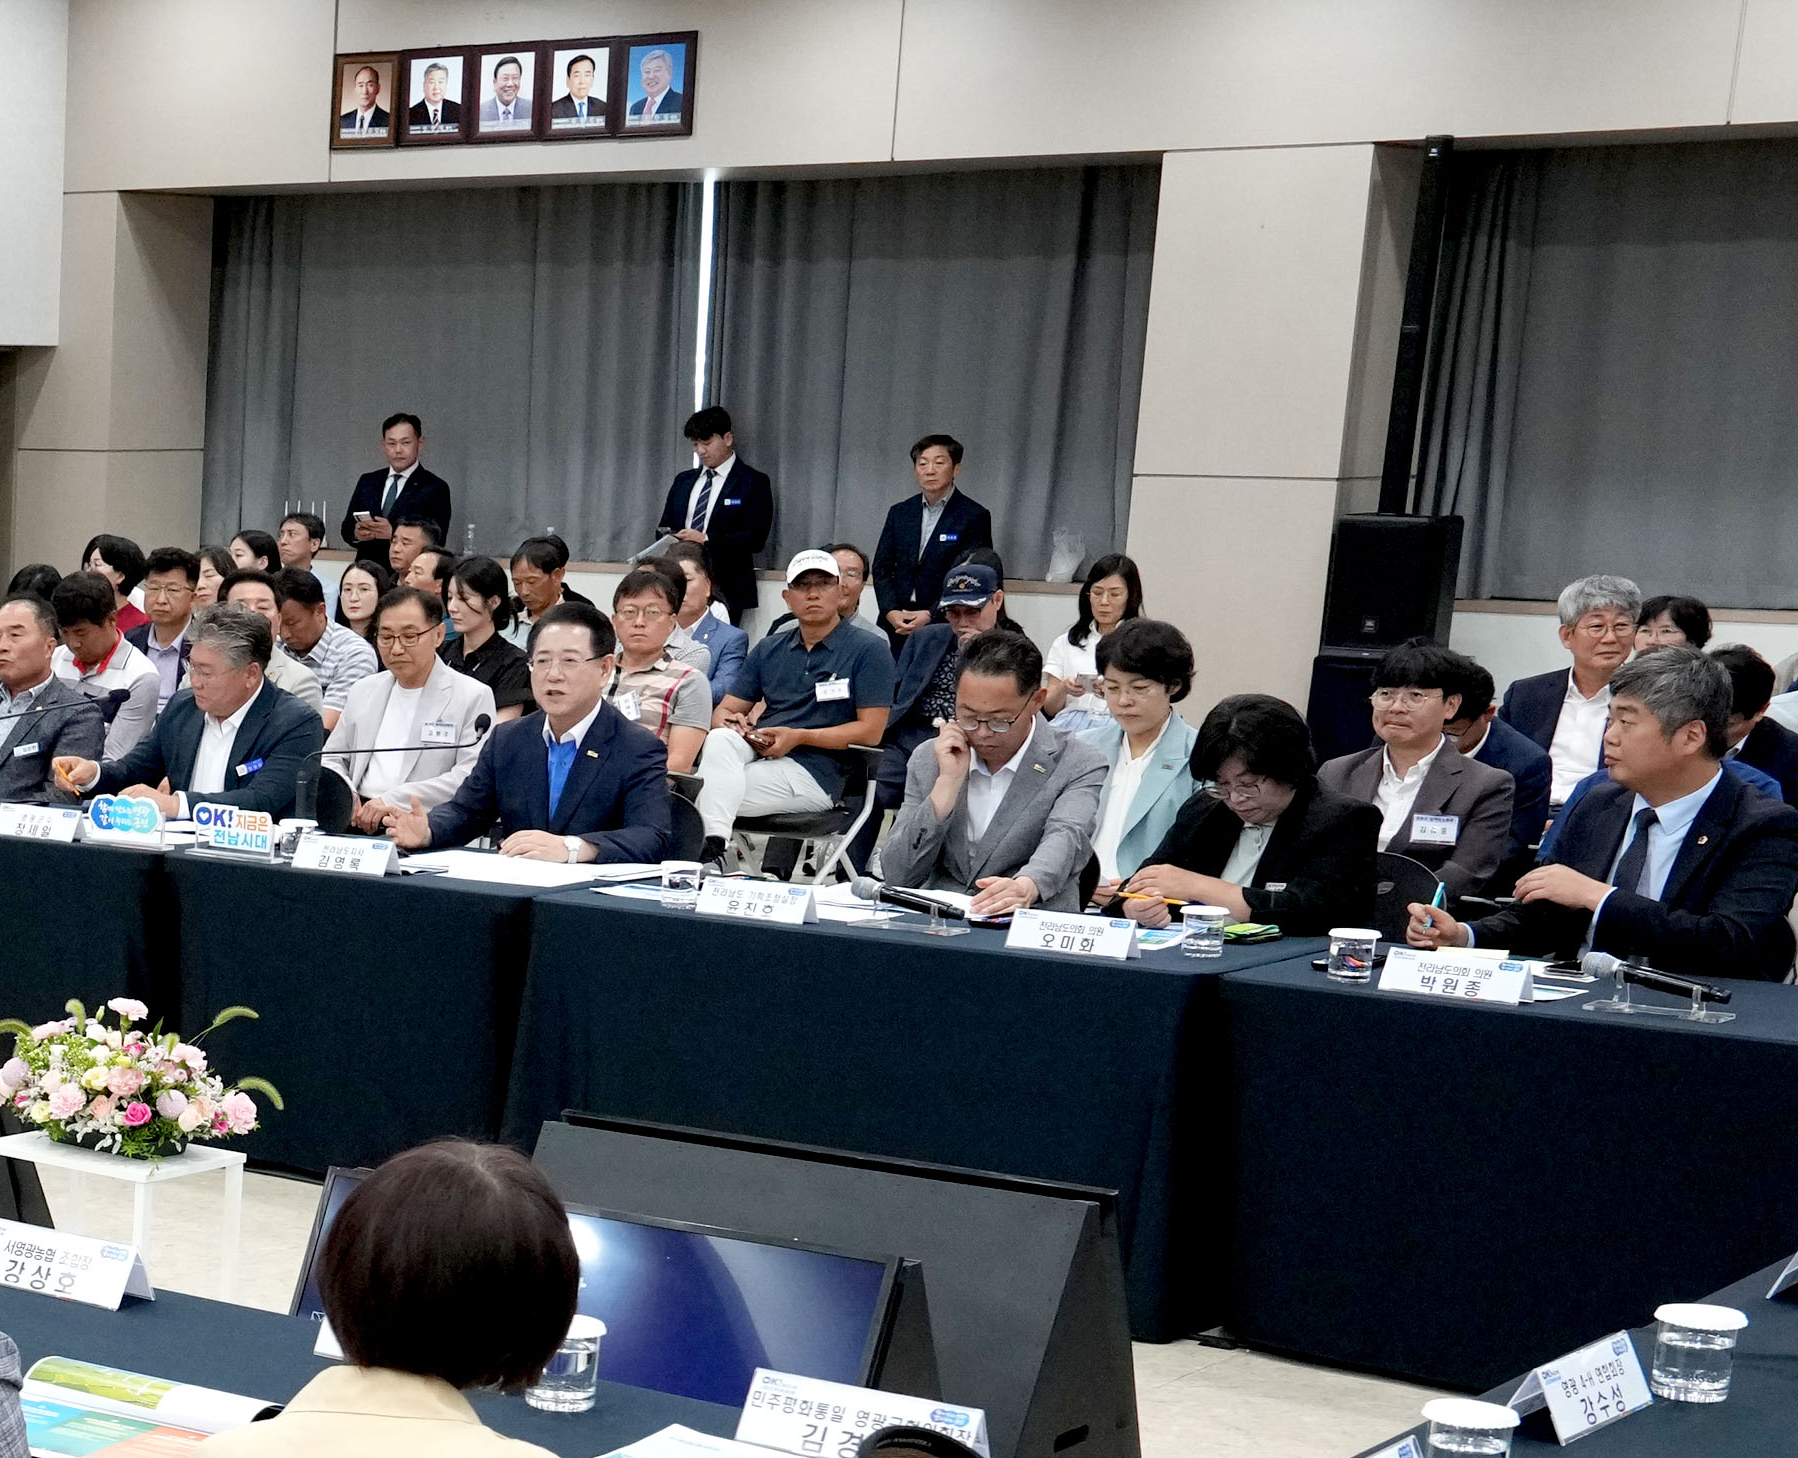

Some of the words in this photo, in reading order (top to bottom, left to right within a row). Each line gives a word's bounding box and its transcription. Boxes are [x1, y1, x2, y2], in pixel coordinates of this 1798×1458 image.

[196, 806, 232, 828] OK!
[235, 814, 269, 832] 지금은
[318, 855, 361, 871] 김영록
[711, 887, 745, 899] 전라남도
[726, 900, 775, 918] 윤진호
[1039, 921, 1086, 935] 전라남도의회
[1088, 926, 1105, 936] 의원
[1040, 933, 1095, 953] 오미화
[1417, 962, 1471, 977] 전라남도의회
[1473, 968, 1493, 980] 의원
[1420, 975, 1481, 998] 박원종
[4, 1239, 56, 1262] 서영광농협
[59, 1250, 93, 1271] 조합장
[4, 1259, 77, 1294] 강상호
[1561, 1378, 1579, 1398] 영광
[1595, 1358, 1625, 1384] 연합회장
[751, 1390, 847, 1423] 민주평화통일
[1580, 1383, 1626, 1425] 강수성
